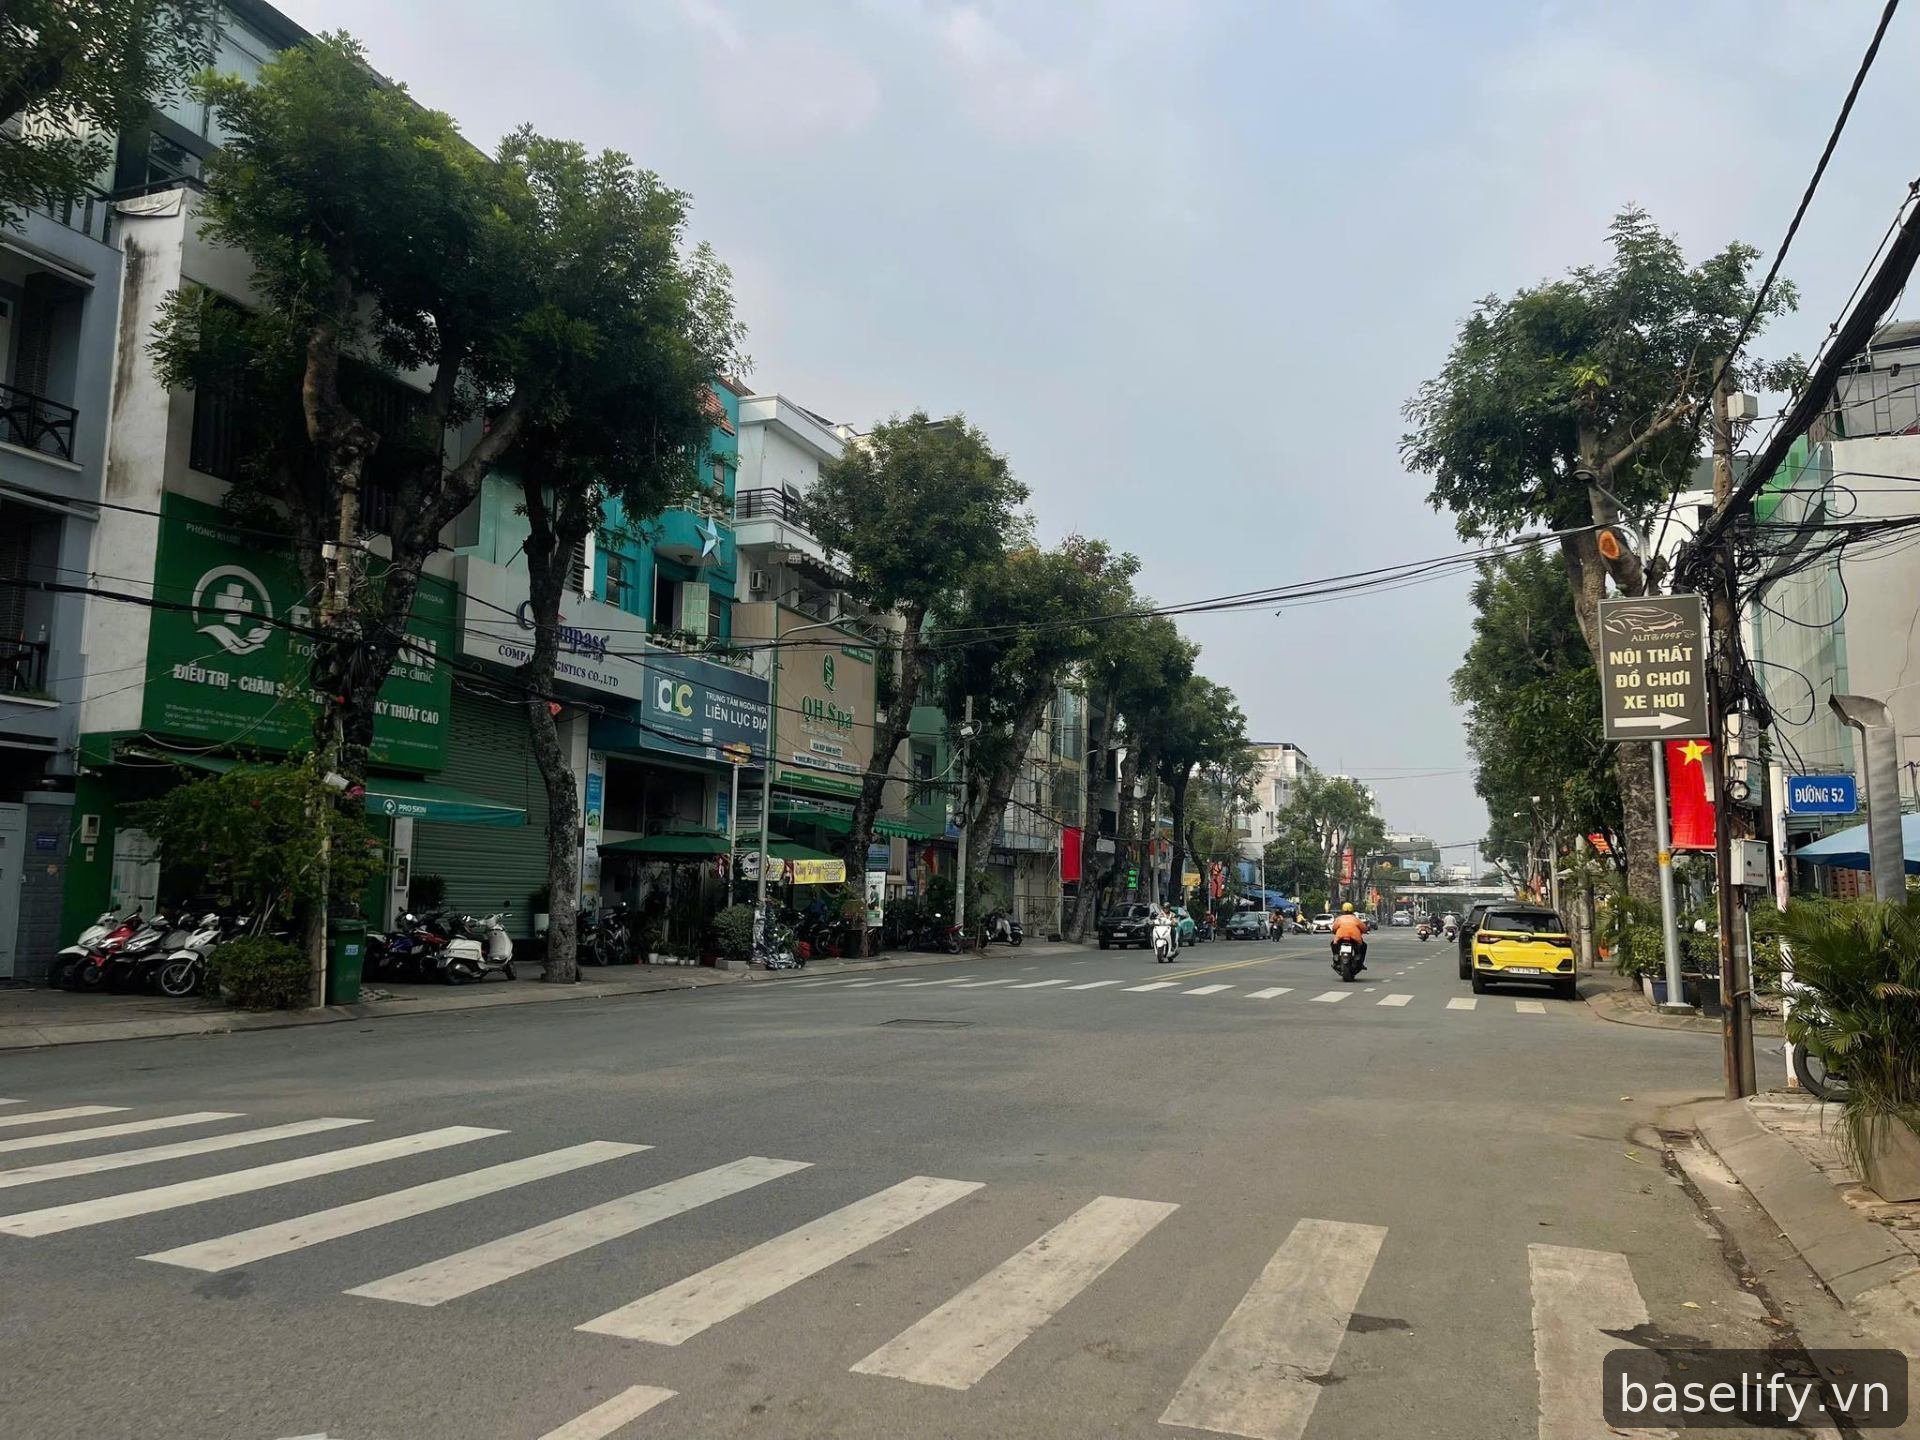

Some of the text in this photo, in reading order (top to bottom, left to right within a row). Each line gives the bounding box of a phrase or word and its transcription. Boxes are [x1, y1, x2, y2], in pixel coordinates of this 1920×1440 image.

[1609, 643, 1693, 667] NỘI THẤT
[206, 669, 229, 690] TRỊ
[239, 675, 275, 696] CHĂM
[409, 665, 434, 684] clinic
[1615, 668, 1691, 688] ĐỒ CHƠI
[705, 691, 726, 704] TRUNG
[1623, 692, 1685, 710] XE HƠI
[390, 702, 421, 723] THUẬT
[421, 709, 439, 725] CAO
[705, 703, 728, 722] LIÊN
[730, 710, 751, 728] LỤC
[752, 715, 768, 733] ĐỊA
[1795, 784, 1845, 803] ĐƯỜNG 52
